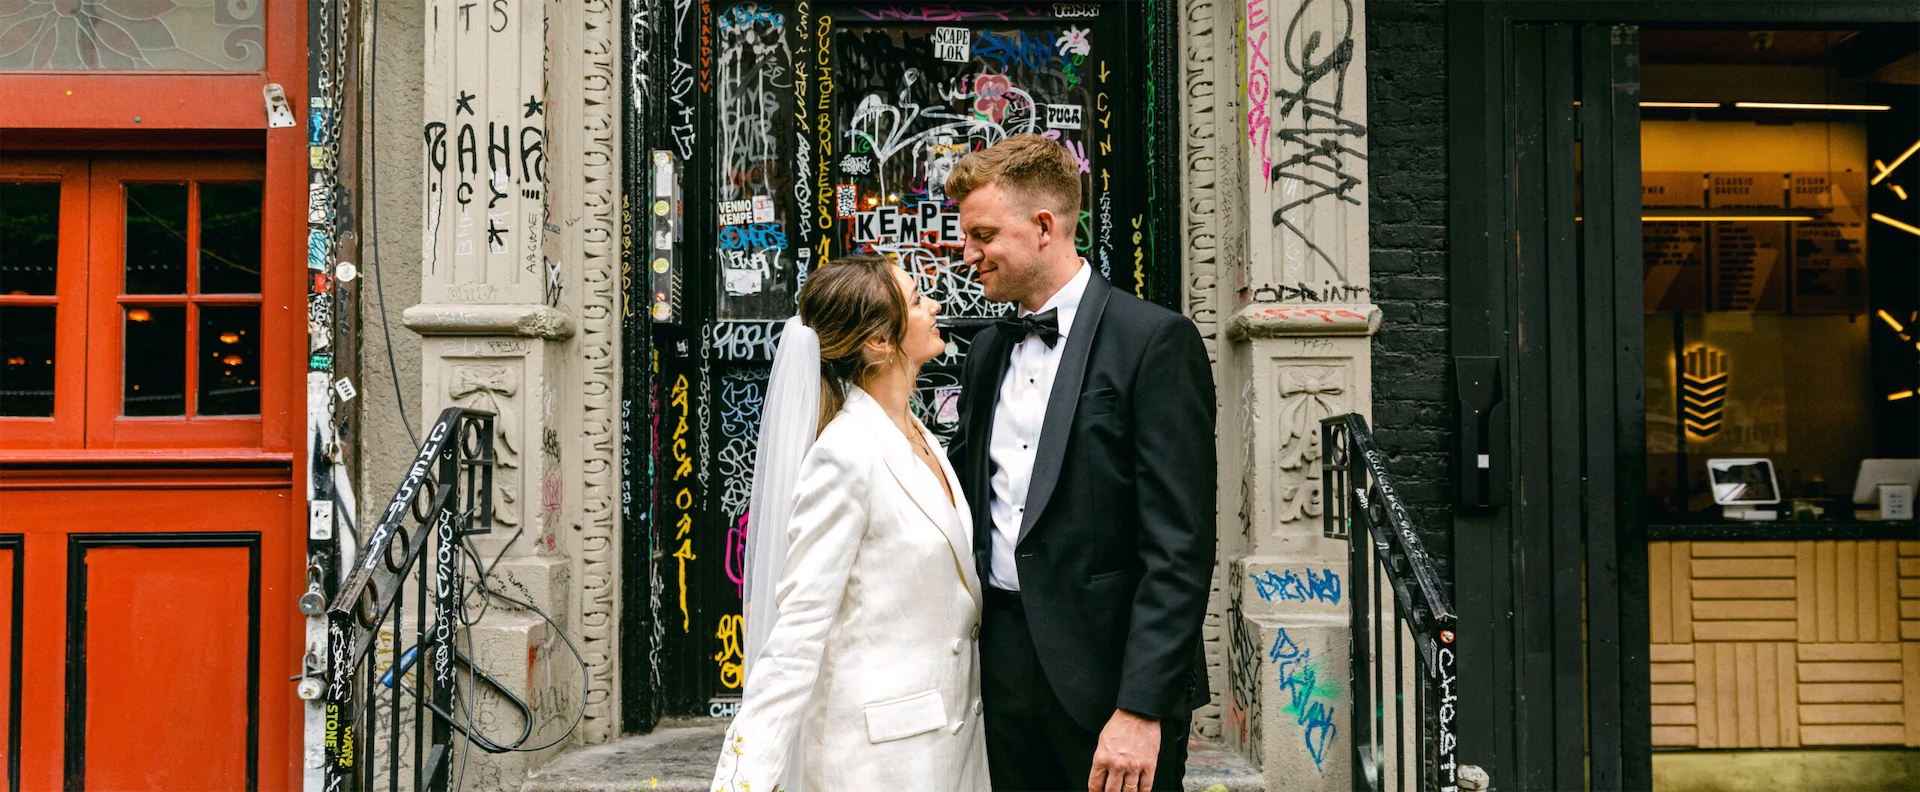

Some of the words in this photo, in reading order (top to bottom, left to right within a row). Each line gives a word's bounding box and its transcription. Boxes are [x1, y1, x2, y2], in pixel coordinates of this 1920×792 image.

[936, 28, 969, 45] SCAPE
[941, 45, 964, 61] LOK
[1049, 107, 1081, 124] PUCA
[719, 200, 751, 214] VENMO
[719, 212, 753, 225] KEMPE
[858, 203, 959, 243] KEMPE
